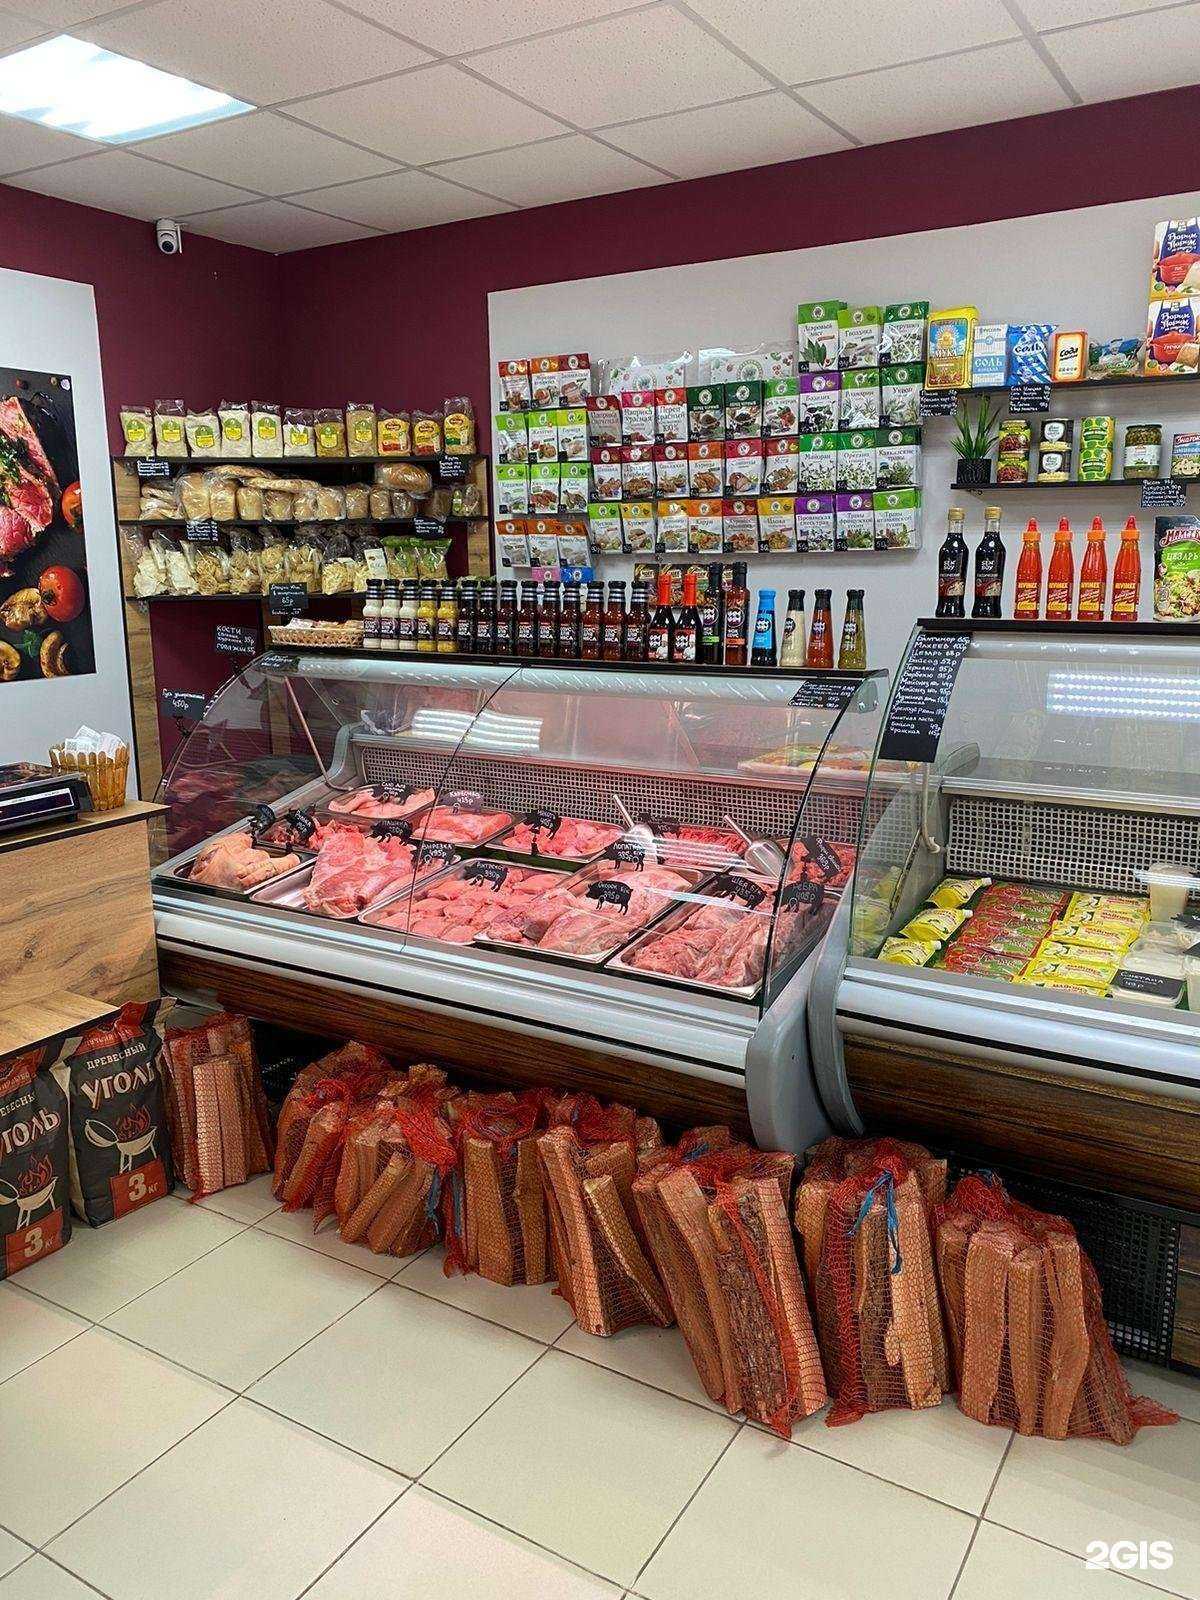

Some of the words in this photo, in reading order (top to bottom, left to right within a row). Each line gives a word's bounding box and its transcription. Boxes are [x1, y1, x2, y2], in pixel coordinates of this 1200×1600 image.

[1166, 552, 1199, 561] ЦЕЗАРЬ
[216, 626, 242, 636] КОСТИ
[86, 1042, 147, 1070] ДРЕВЕСНЫЙ
[80, 1061, 155, 1110] УГОЛЬ
[128, 1172, 147, 1202] 3
[24, 1226, 44, 1258] 3
